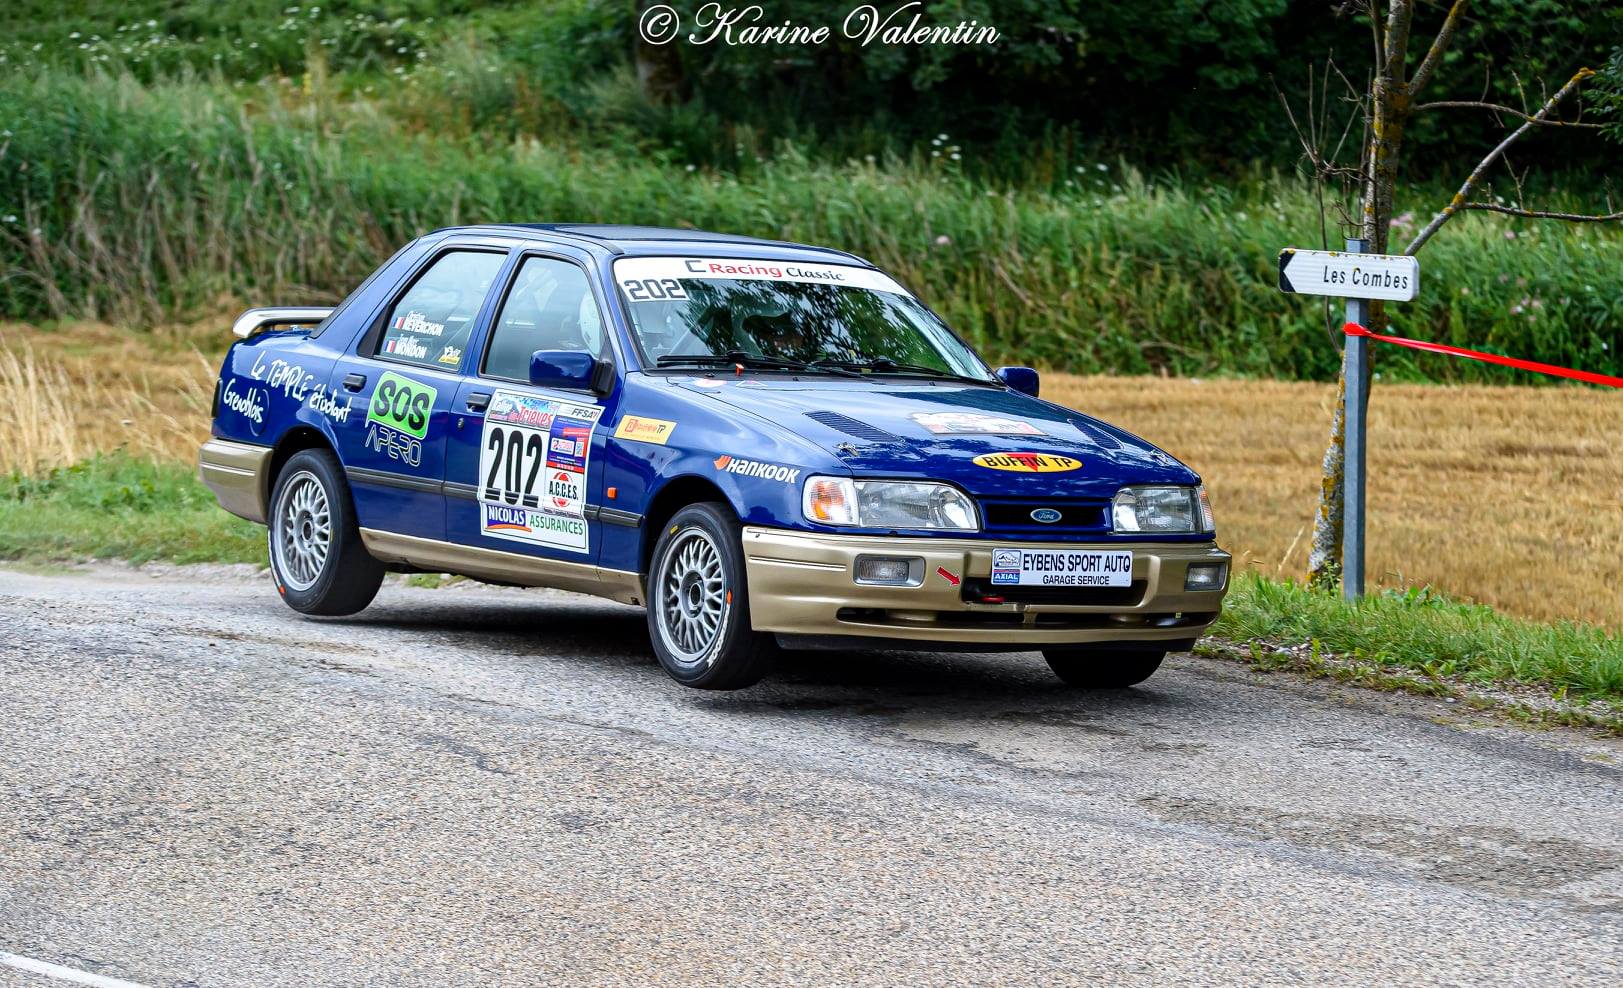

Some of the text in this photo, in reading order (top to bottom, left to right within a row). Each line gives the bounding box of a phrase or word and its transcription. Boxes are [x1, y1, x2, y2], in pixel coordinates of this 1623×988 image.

[708, 263, 783, 278] Racing
[786, 267, 846, 281] Classic
[1323, 265, 1408, 289] Les Combes
[624, 279, 687, 300] 202
[250, 350, 267, 381] Le
[266, 358, 313, 401] TEMPLE
[374, 379, 430, 431] SOS
[571, 408, 594, 419] FFSA
[484, 427, 543, 509] 202
[982, 456, 1073, 469] BUFFIN TP
[549, 480, 579, 500] A.C.C.E.S.
[488, 505, 525, 526] NICOLAS
[529, 514, 584, 536] ASSURANCES
[1038, 511, 1056, 521] Ford
[1023, 553, 1131, 573] EYBENS SPORT AUTO
[1042, 575, 1110, 585] GARAGE SERVICE
